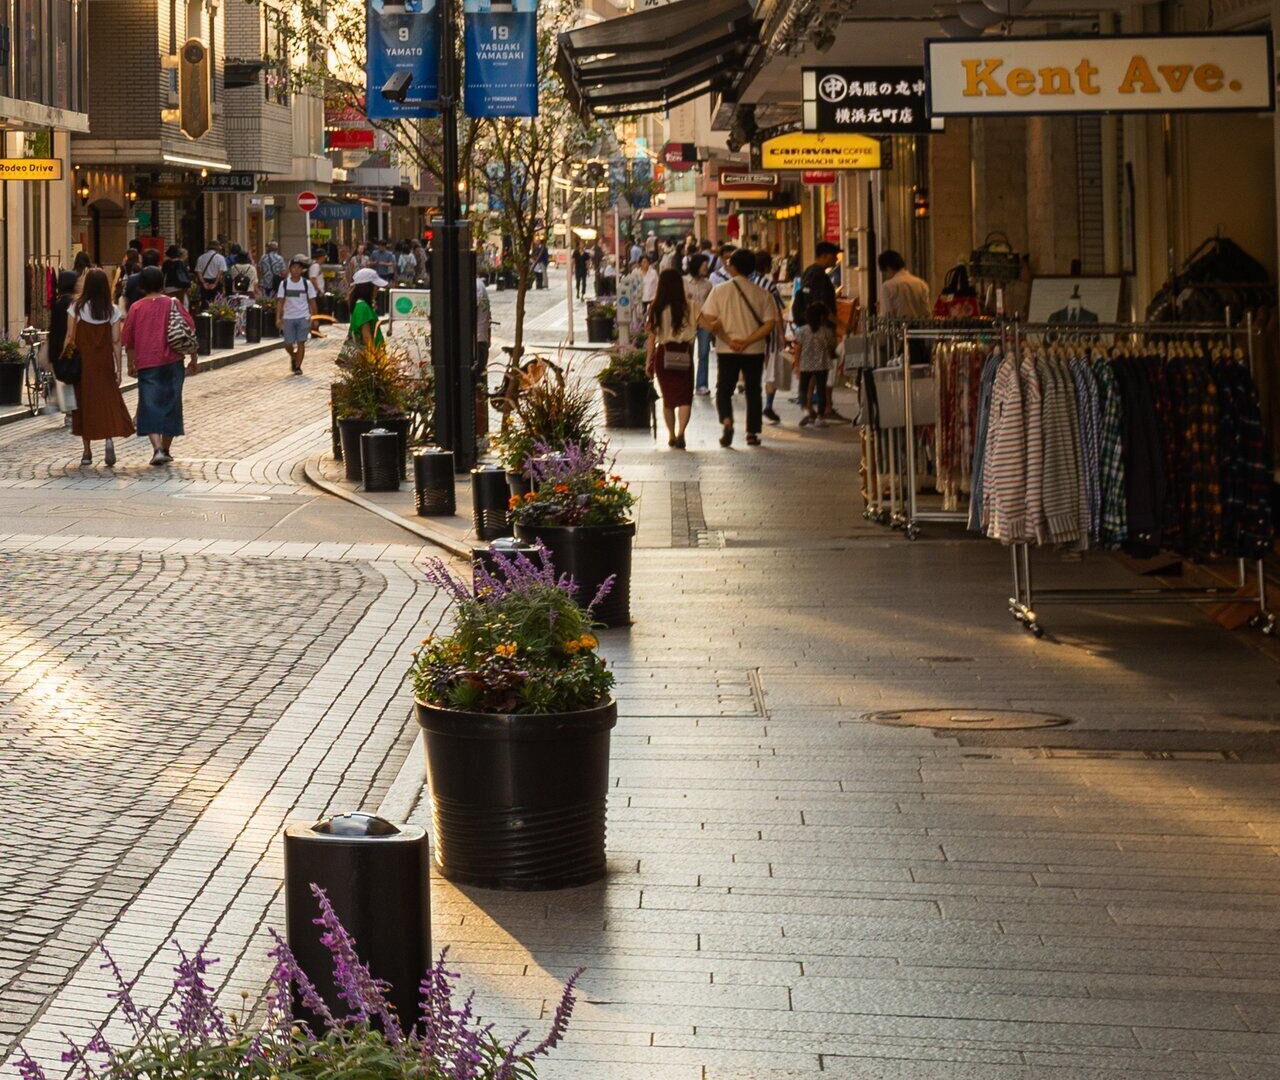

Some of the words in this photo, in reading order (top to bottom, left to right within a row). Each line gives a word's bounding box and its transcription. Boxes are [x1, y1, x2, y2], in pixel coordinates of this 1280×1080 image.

[398, 27, 410, 42] 9
[489, 25, 510, 40] 19
[385, 47, 423, 57] YAMATO
[480, 42, 521, 51] YASUAKI
[475, 51, 524, 61] YAMASAKI
[961, 57, 1101, 98] Kent
[1118, 55, 1243, 93] Ave.
[848, 78, 926, 97] 呉服の丸中
[834, 107, 914, 124] 横浜元町店
[769, 147, 842, 156] CARAVAN
[843, 147, 873, 155] COFFEE
[29, 164, 54, 173] Drive
